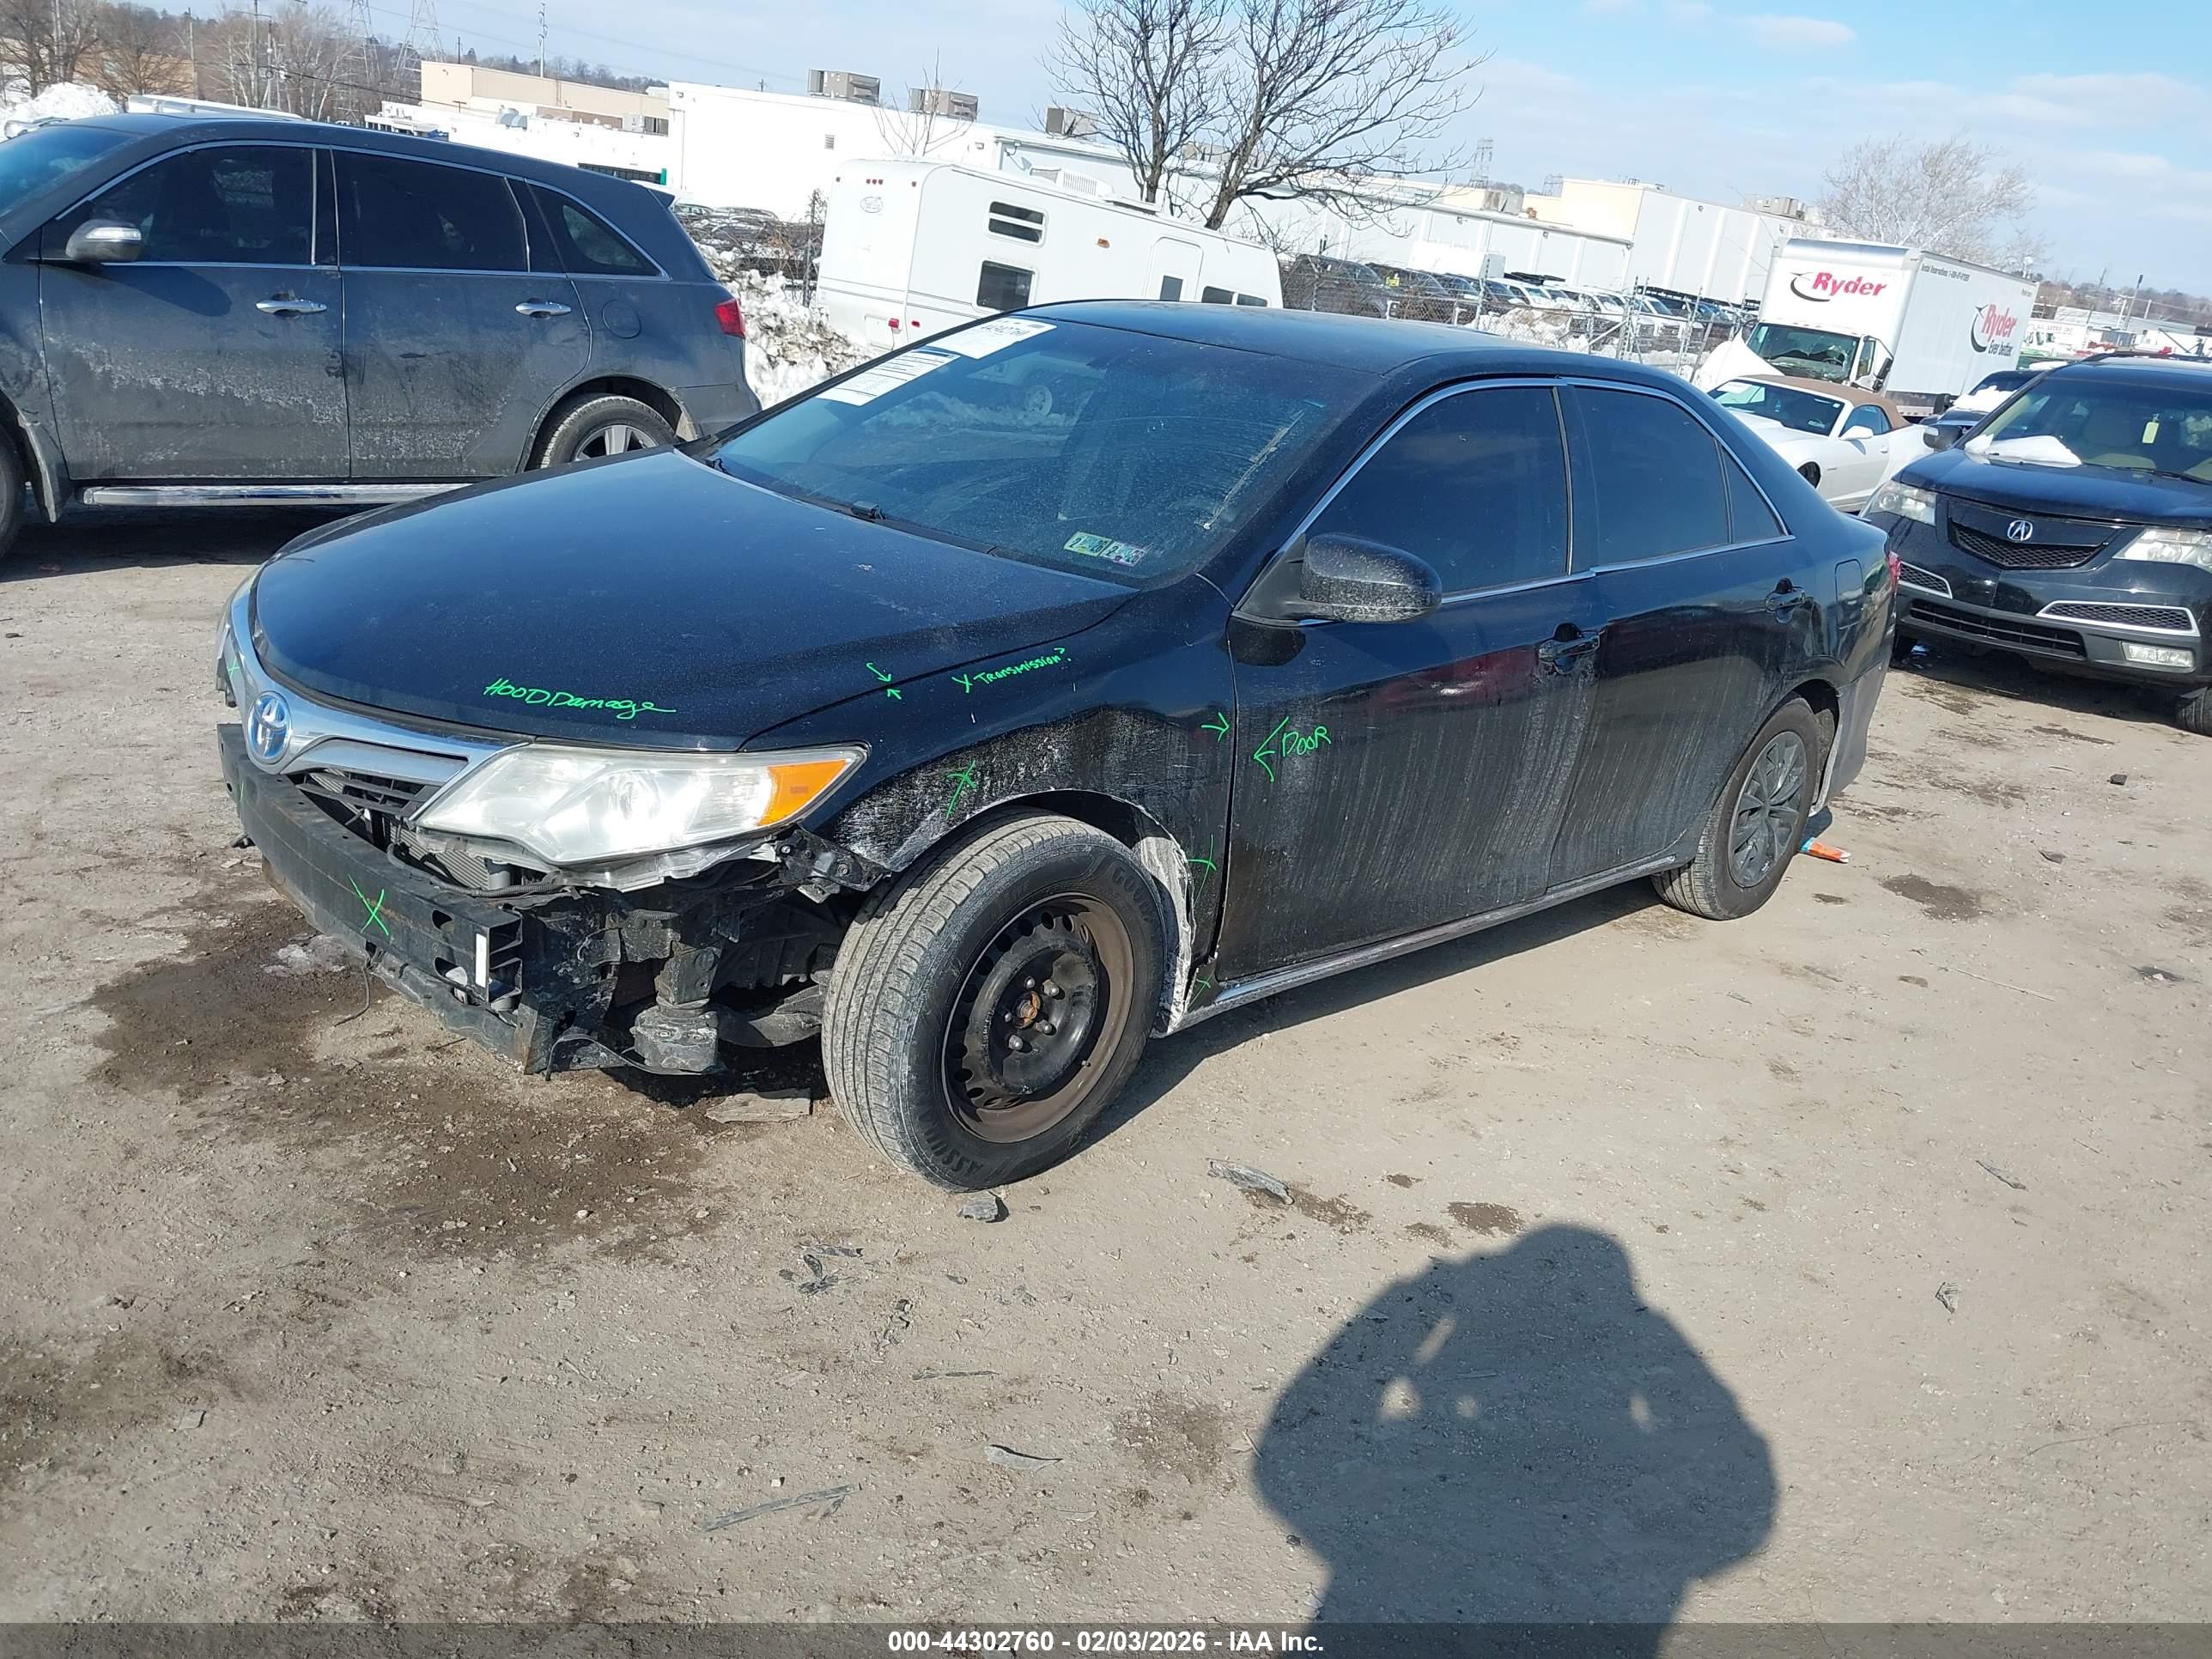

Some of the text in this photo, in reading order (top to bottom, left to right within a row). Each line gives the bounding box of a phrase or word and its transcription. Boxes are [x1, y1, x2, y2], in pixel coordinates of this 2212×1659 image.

[1812, 272, 1887, 296] Ryder
[1982, 303, 2019, 342] Ryder
[973, 647, 1072, 684] Transmission?
[547, 691, 677, 720] Damage
